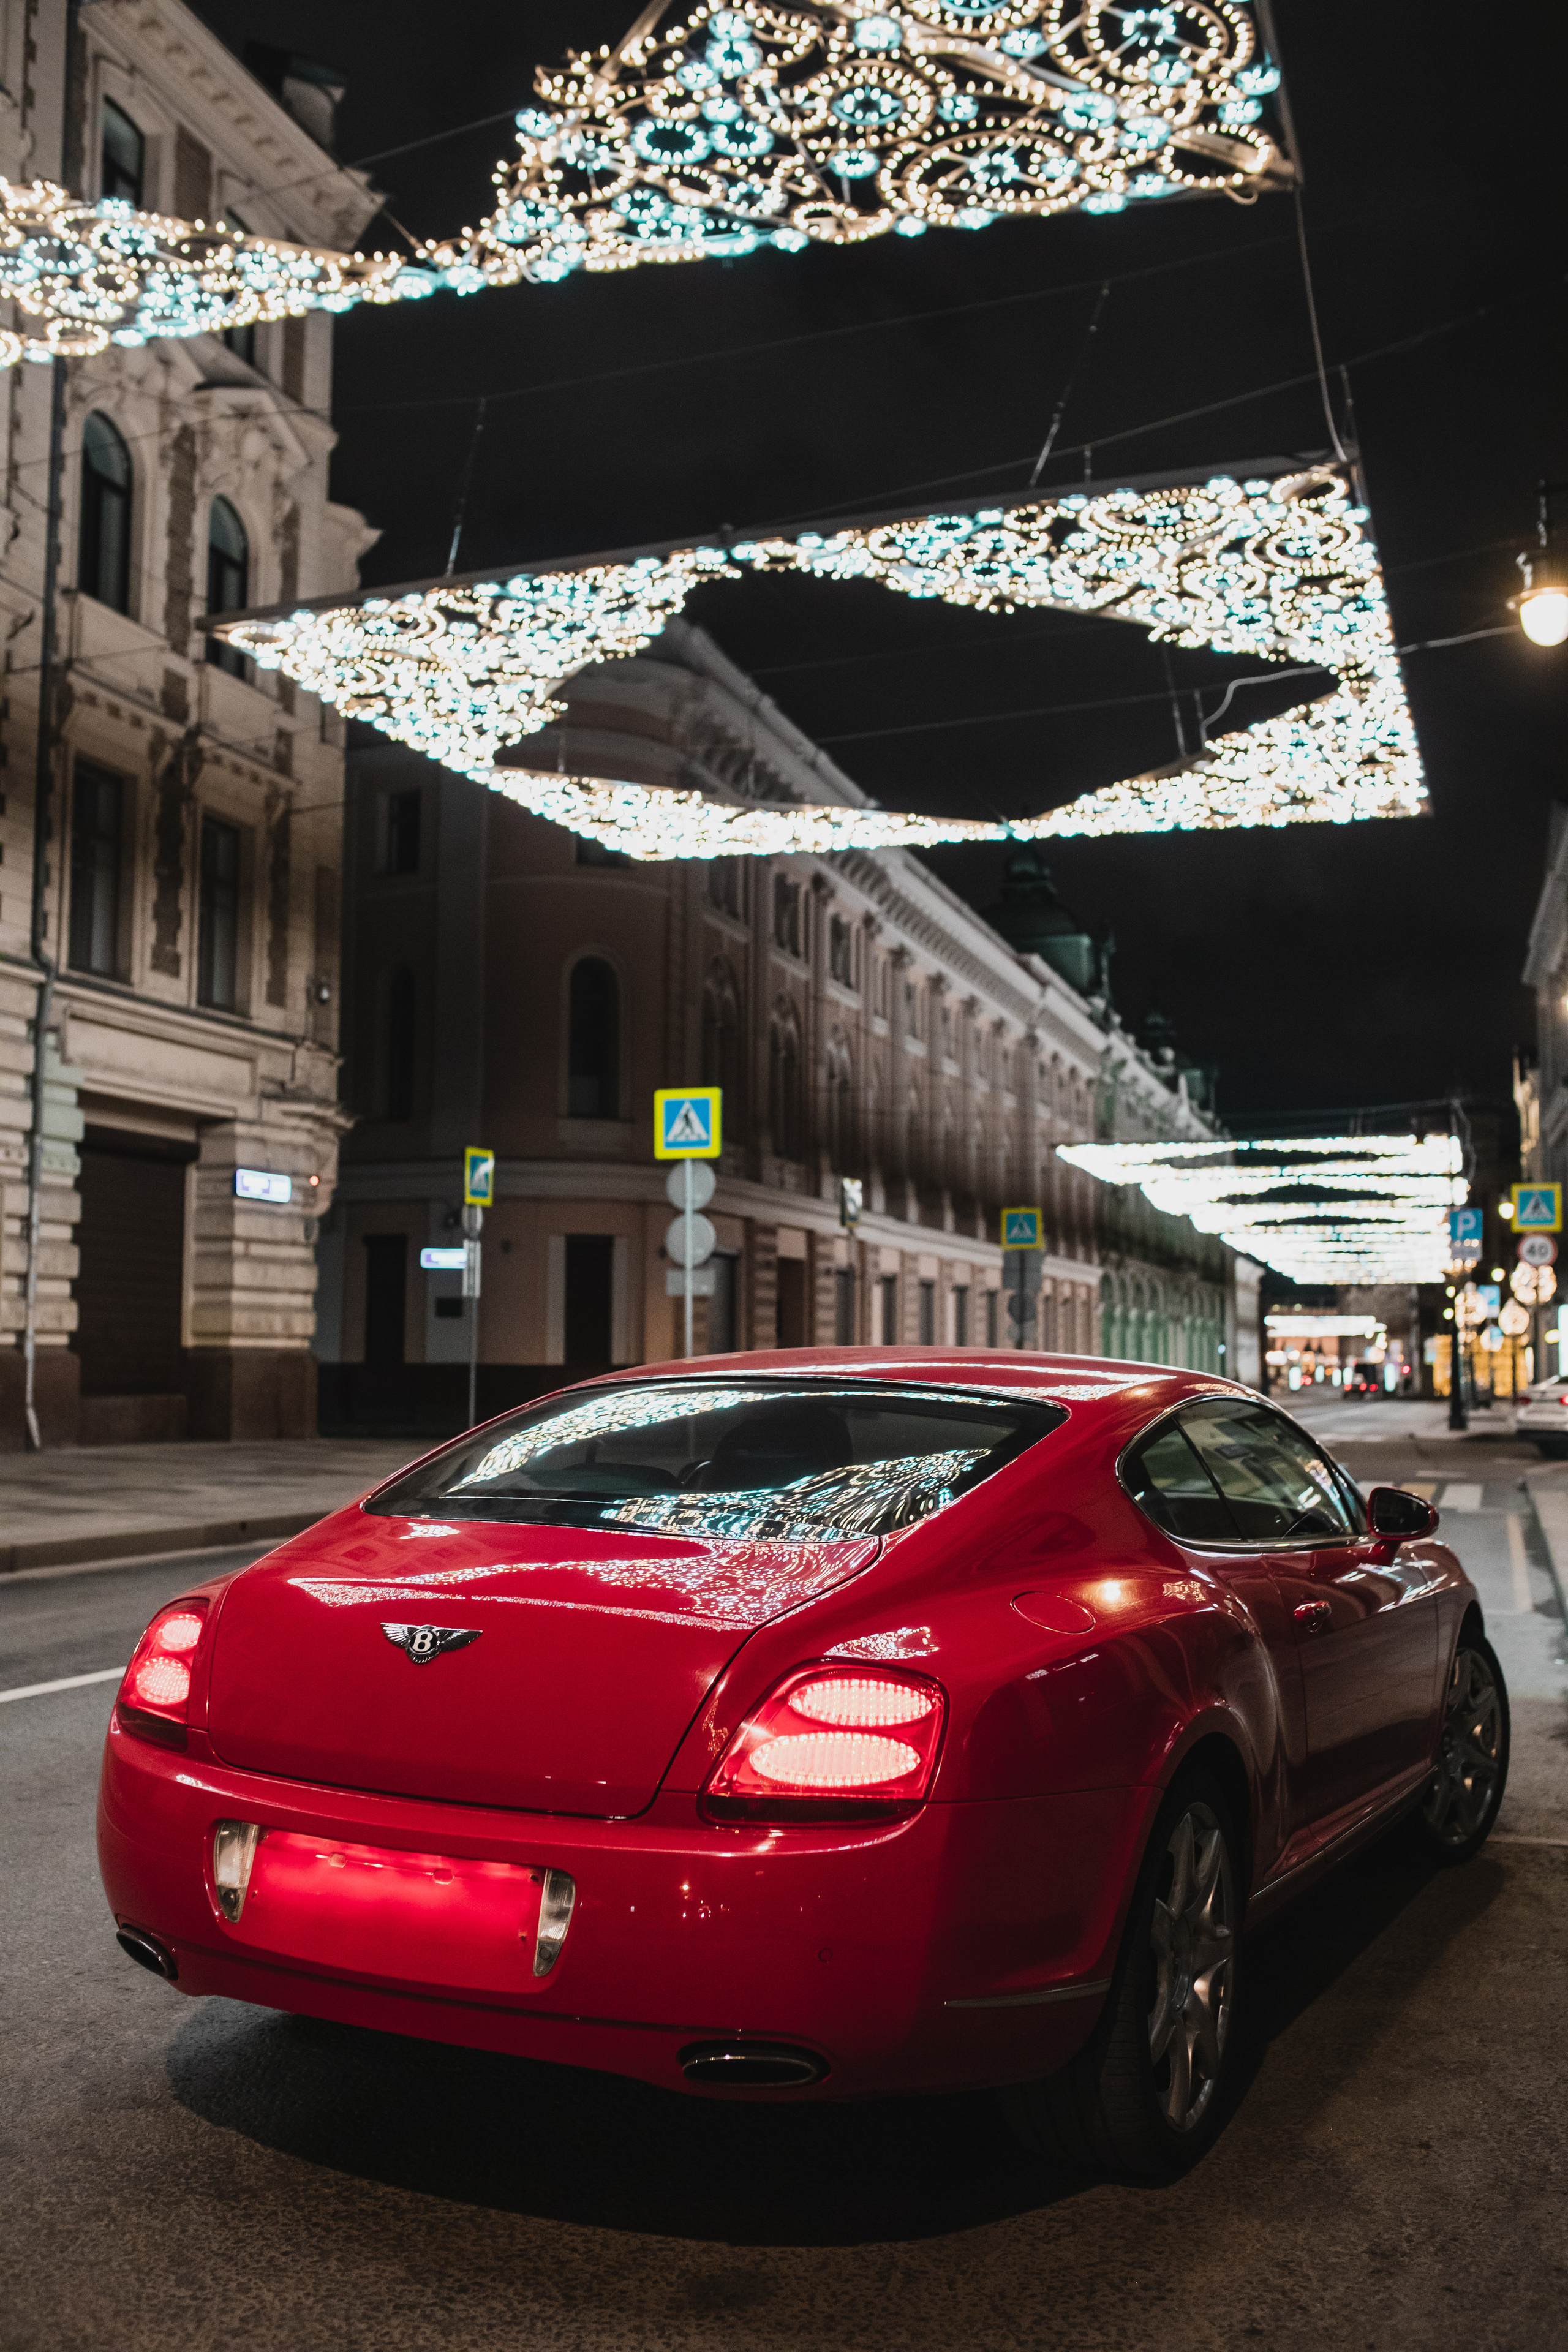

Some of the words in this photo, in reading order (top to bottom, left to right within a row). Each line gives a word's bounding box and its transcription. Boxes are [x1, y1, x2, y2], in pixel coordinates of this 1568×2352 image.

[1457, 1212, 1476, 1238] P
[1526, 1243, 1549, 1257] 40
[412, 1631, 433, 1652] B
